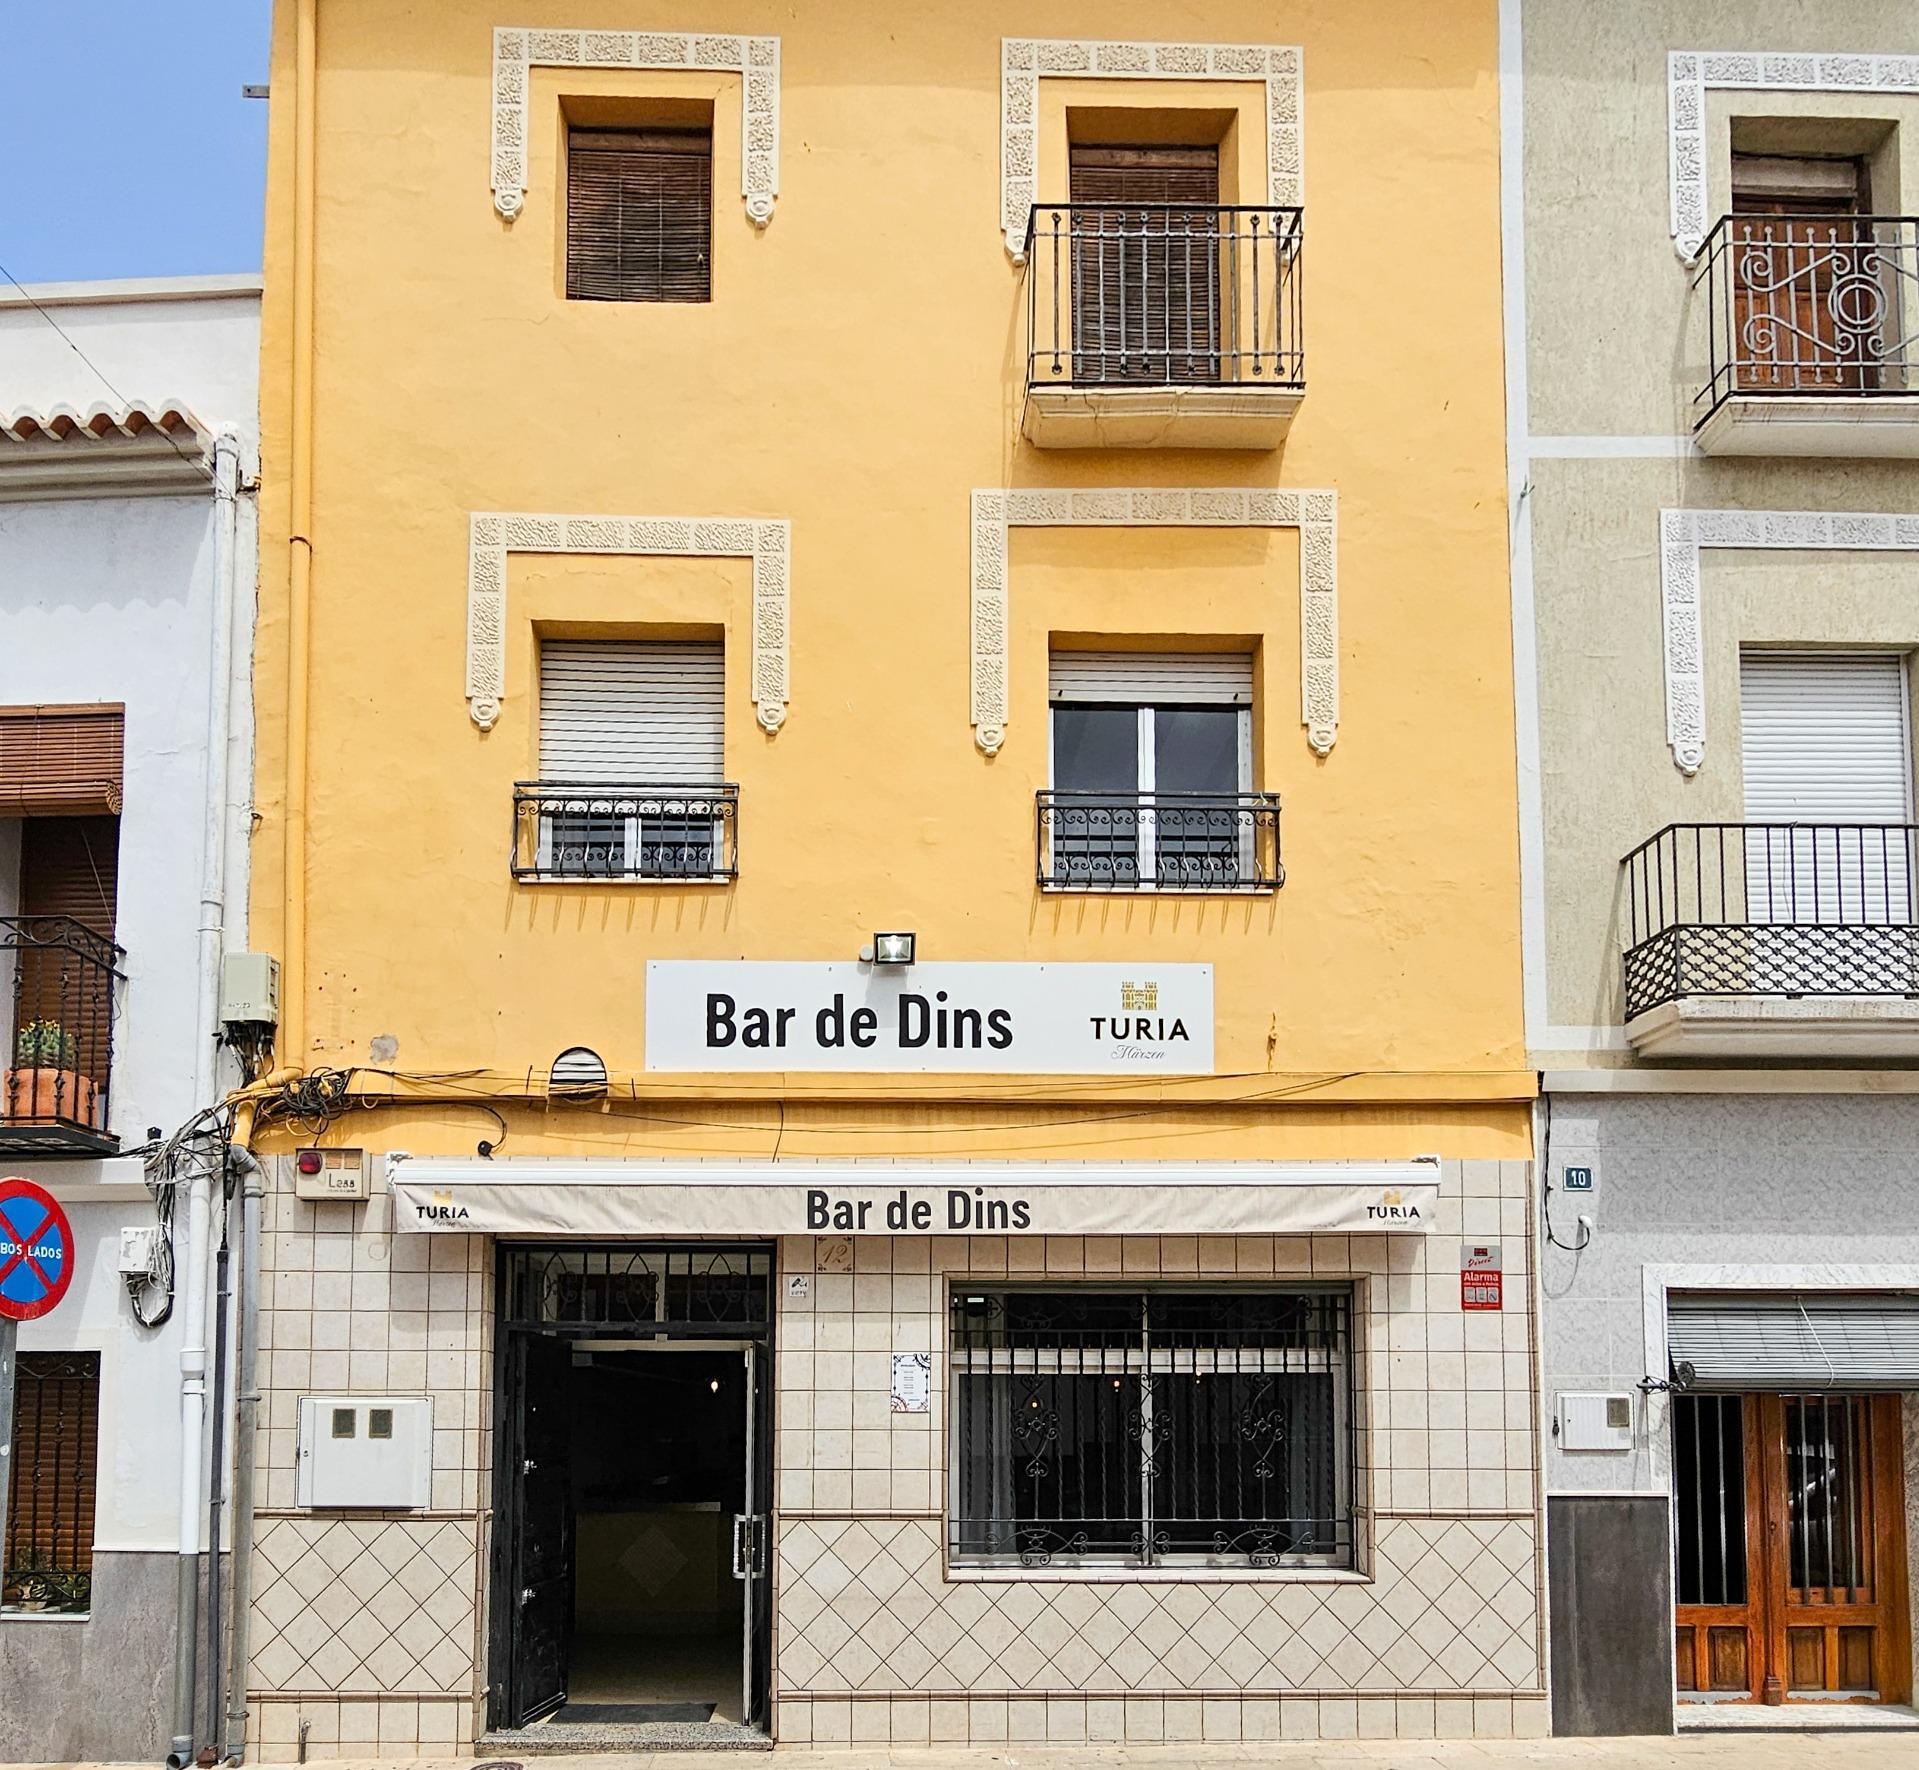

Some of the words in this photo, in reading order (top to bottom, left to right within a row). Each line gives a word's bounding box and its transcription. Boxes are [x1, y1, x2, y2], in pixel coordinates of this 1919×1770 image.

[706, 993, 796, 1048] Bar
[815, 993, 878, 1048] de
[898, 990, 1013, 1050] Dins
[1089, 1017, 1190, 1041] TURIA
[1571, 1170, 1586, 1186] 10
[416, 1206, 470, 1219] TURIA
[807, 1189, 873, 1230] Bar
[886, 1190, 932, 1230] de
[947, 1187, 1031, 1230] Dins
[1366, 1205, 1421, 1219] TURIA
[27, 1245, 62, 1259] LADOS
[823, 1244, 848, 1264] 12
[1463, 1271, 1500, 1282] Alarma
